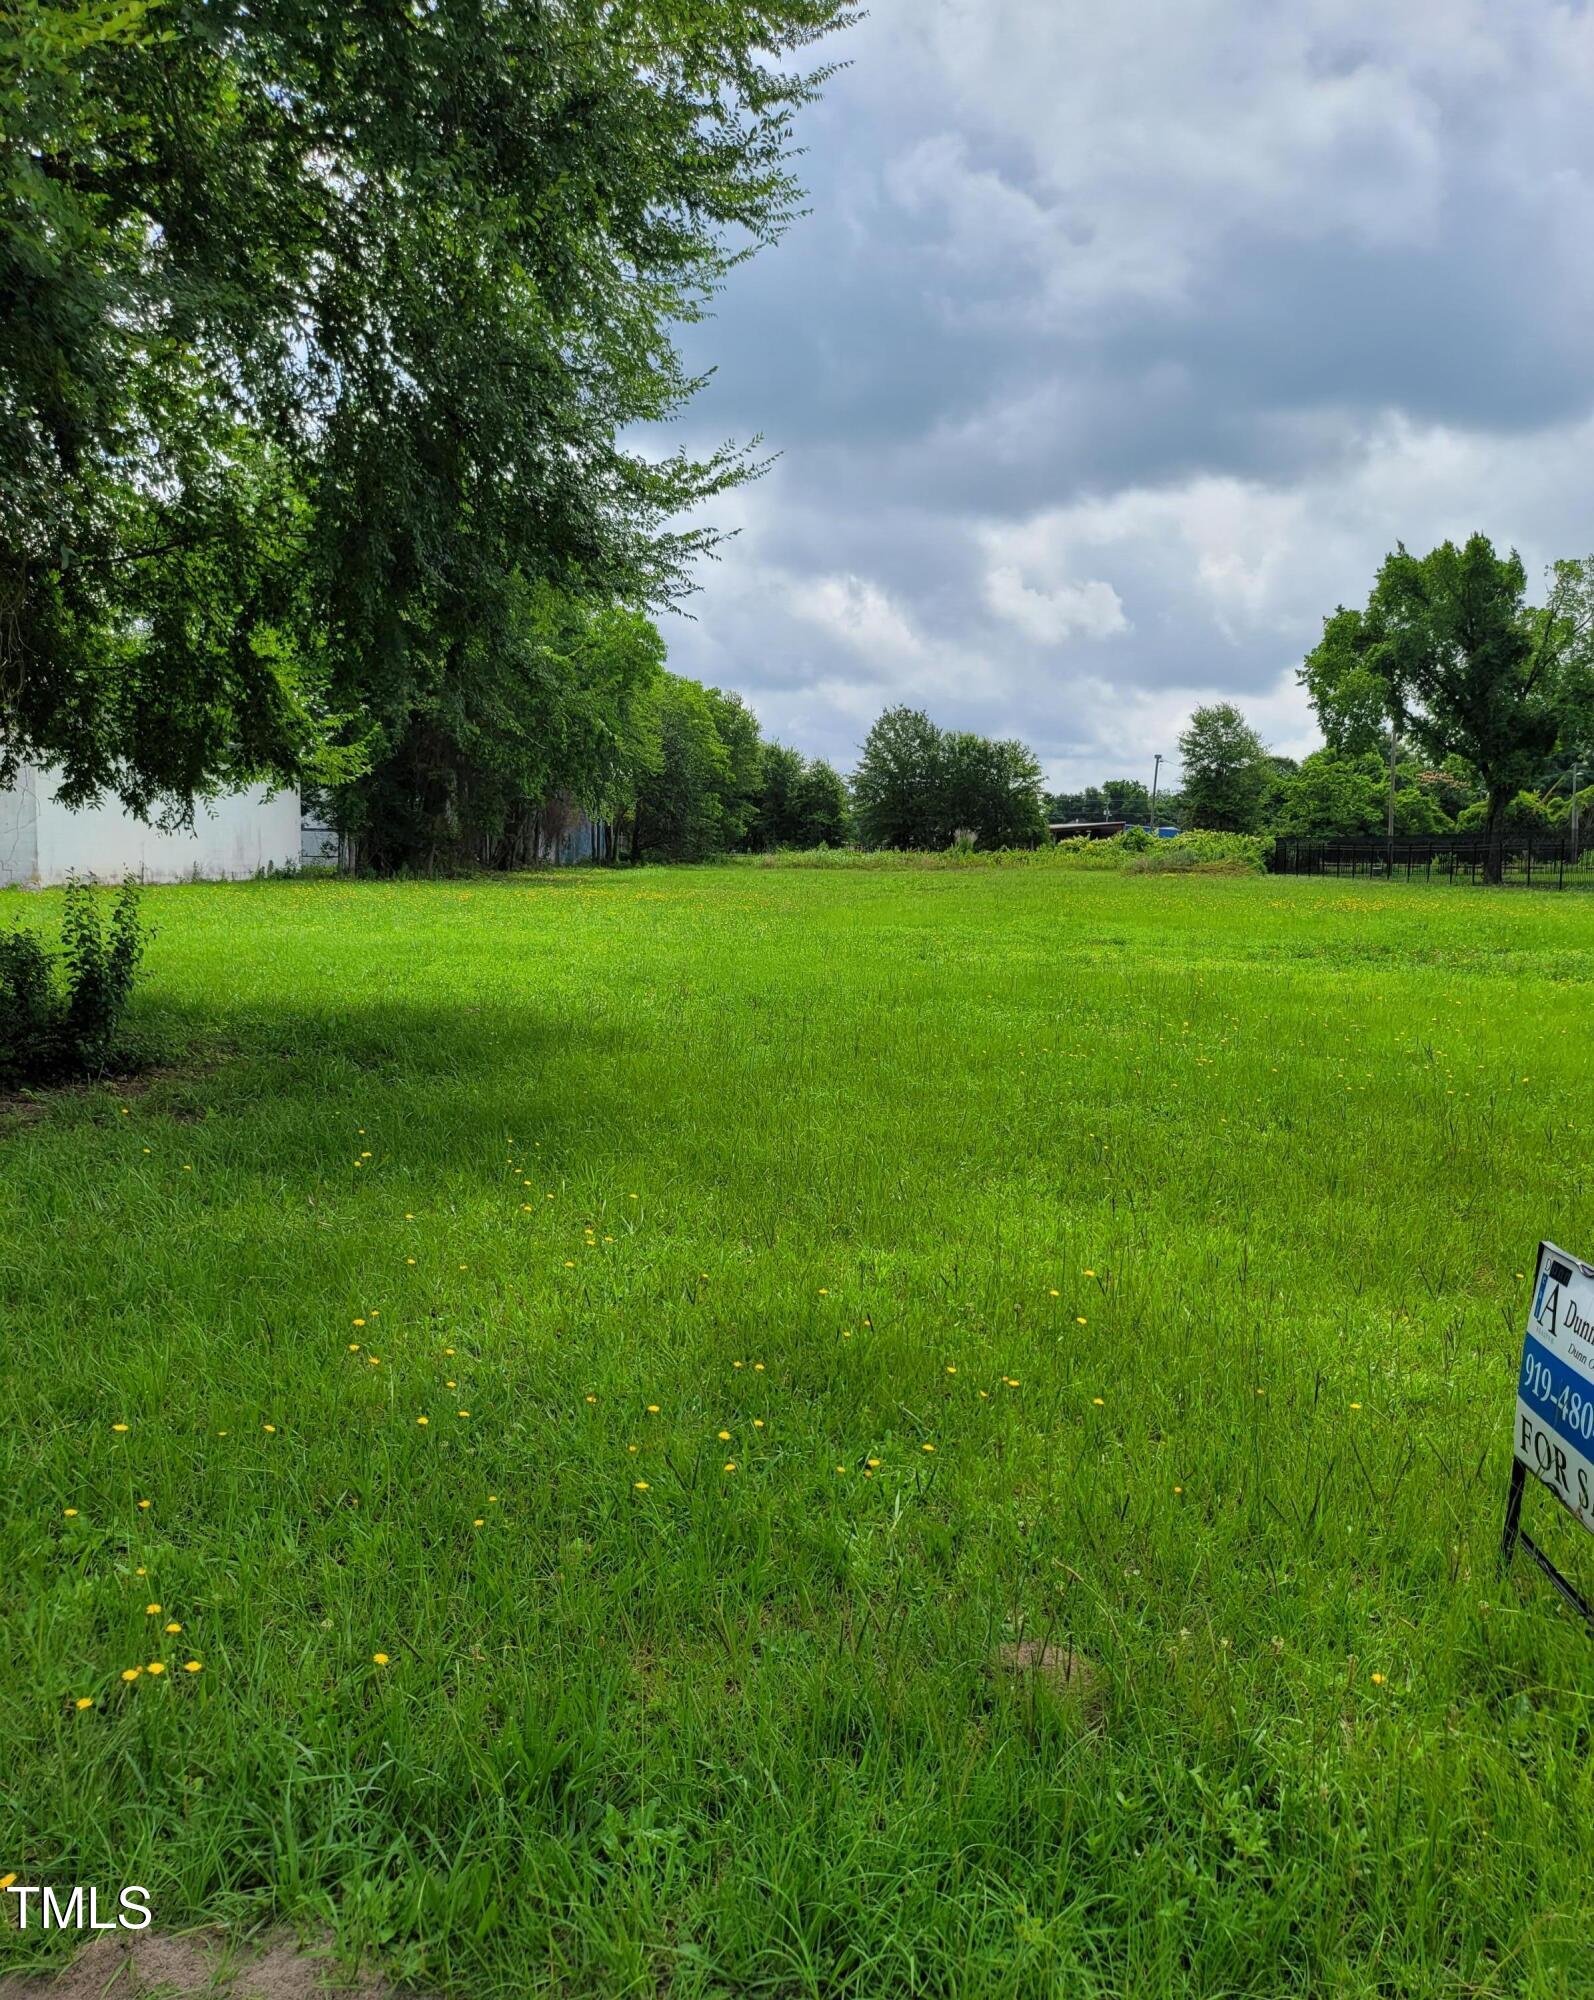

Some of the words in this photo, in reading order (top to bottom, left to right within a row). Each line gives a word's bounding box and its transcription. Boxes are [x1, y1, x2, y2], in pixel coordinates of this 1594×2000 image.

[1524, 1353, 1594, 1439] 919-480
[1568, 1344, 1587, 1364] Dunn
[1520, 1414, 1570, 1493] FOR
[1578, 1468, 1594, 1516] S
